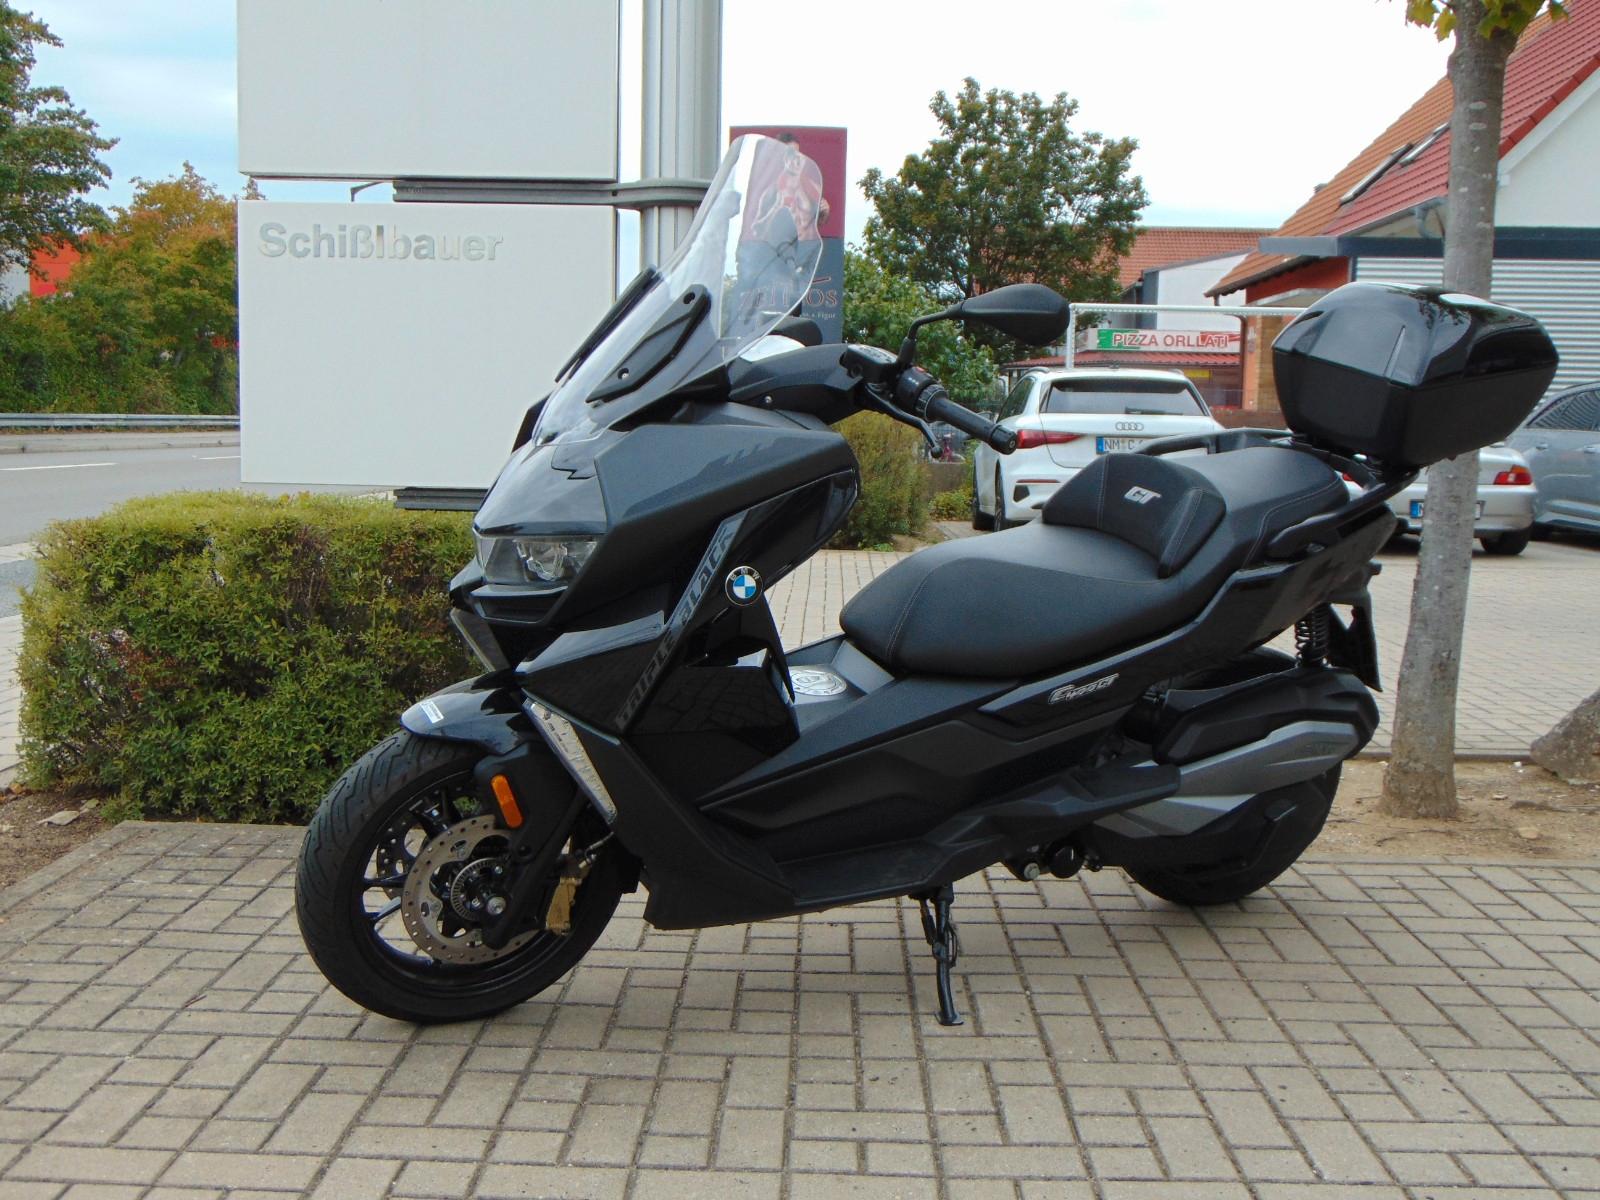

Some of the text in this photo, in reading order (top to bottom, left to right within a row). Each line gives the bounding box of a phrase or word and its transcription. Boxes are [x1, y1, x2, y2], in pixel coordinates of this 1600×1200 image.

[258, 222, 504, 261] Schißlbauer
[1112, 333, 1159, 347] PIZZA
[1104, 439, 1120, 450] NM
[1124, 486, 1162, 504] GT
[729, 567, 761, 581] BMW
